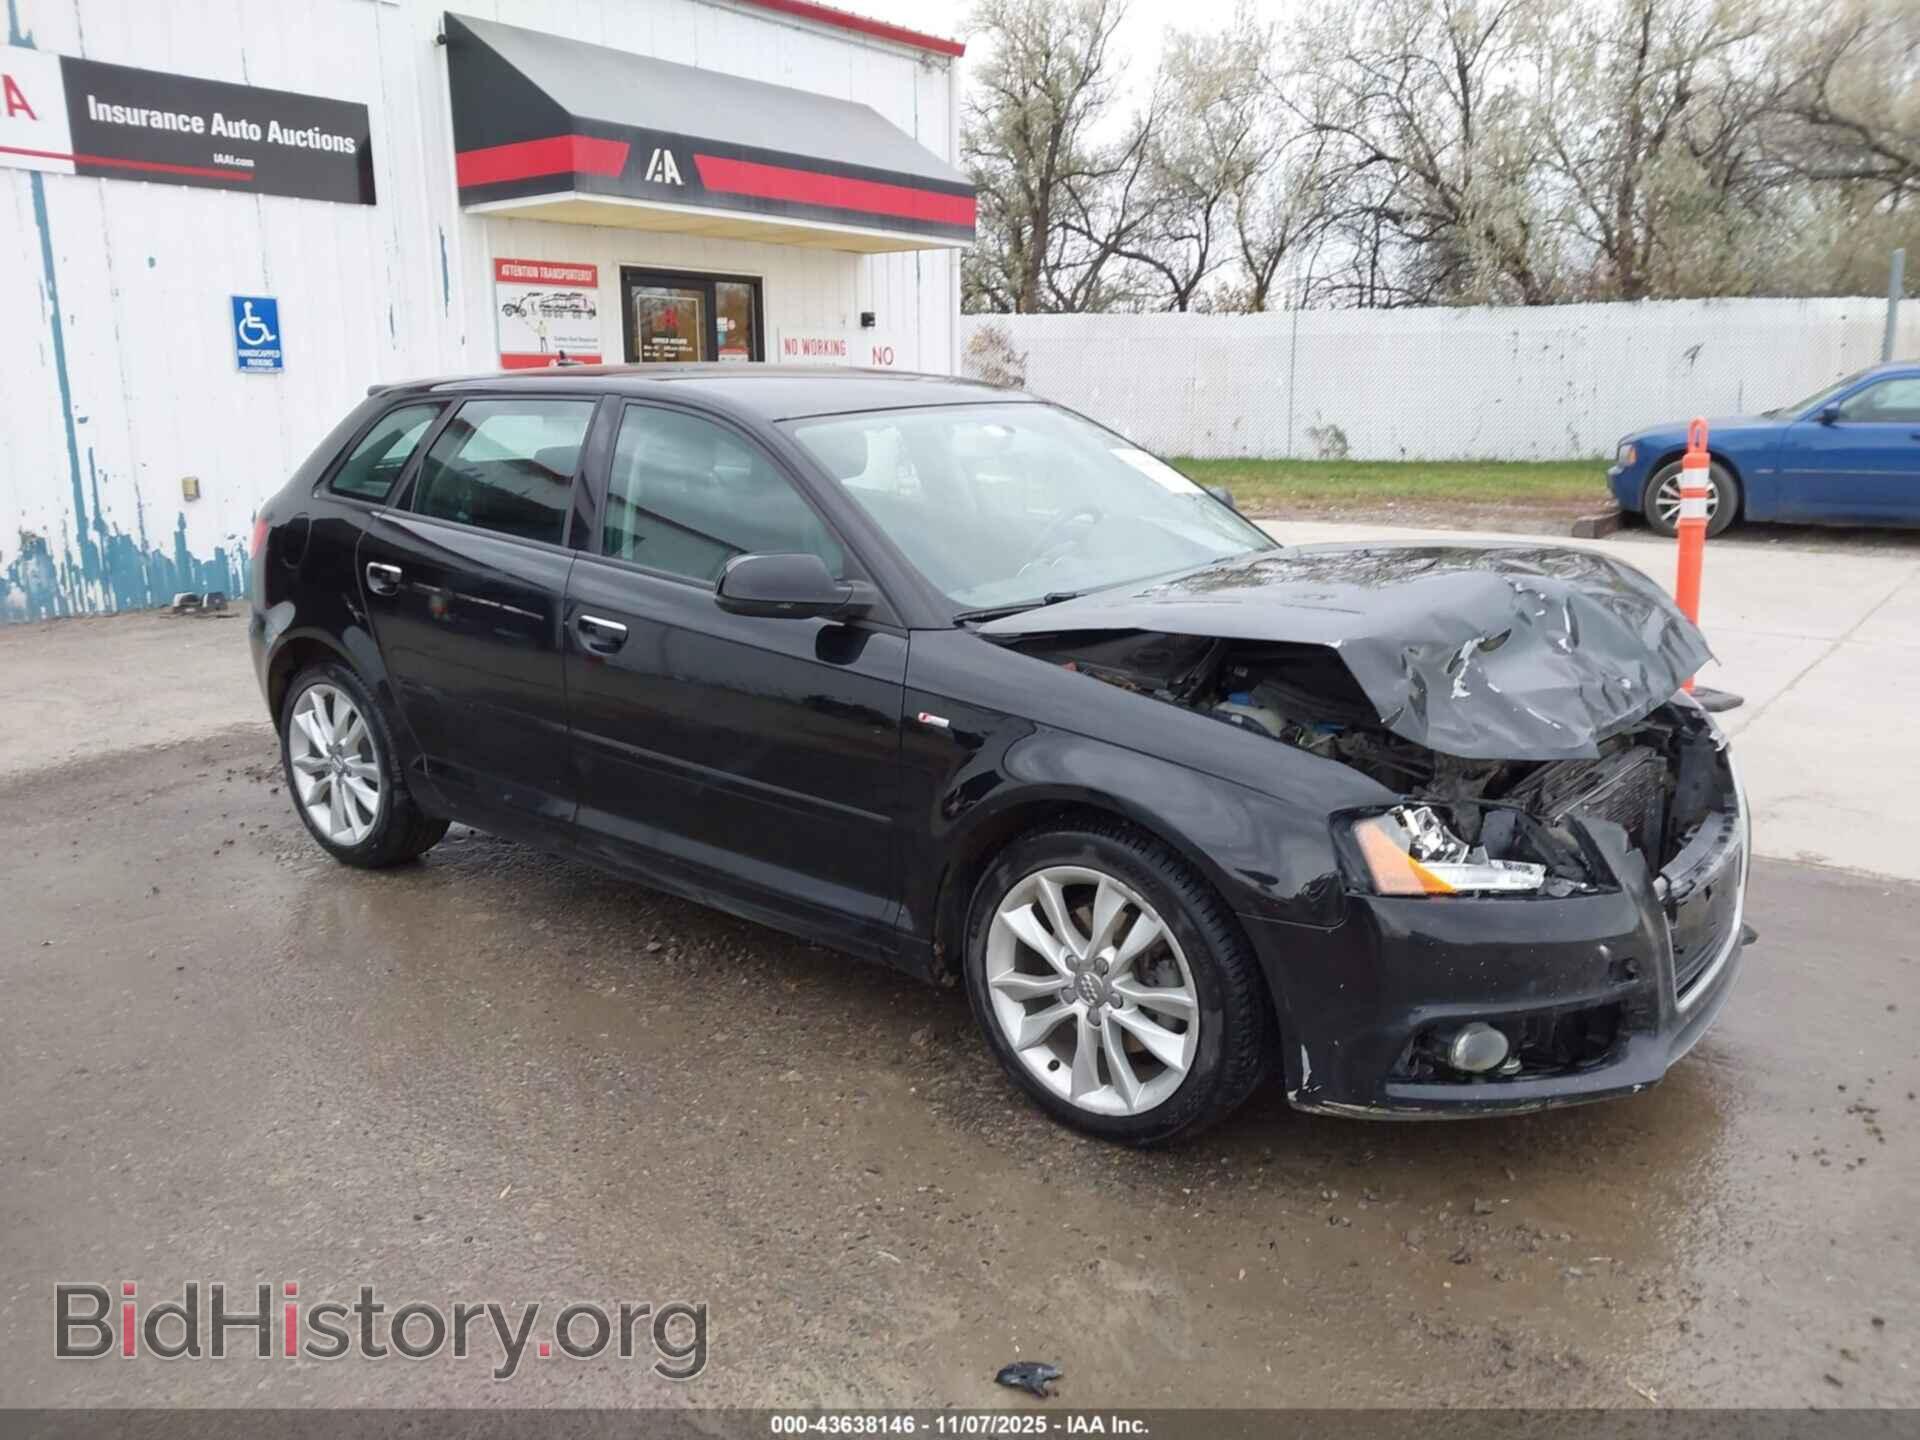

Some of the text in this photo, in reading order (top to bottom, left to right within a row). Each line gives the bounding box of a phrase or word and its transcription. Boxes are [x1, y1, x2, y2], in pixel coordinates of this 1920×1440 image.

[87, 94, 357, 154] Insurance Auto Auctions
[784, 338, 847, 357] NO WORKING
[872, 346, 895, 367] NO
